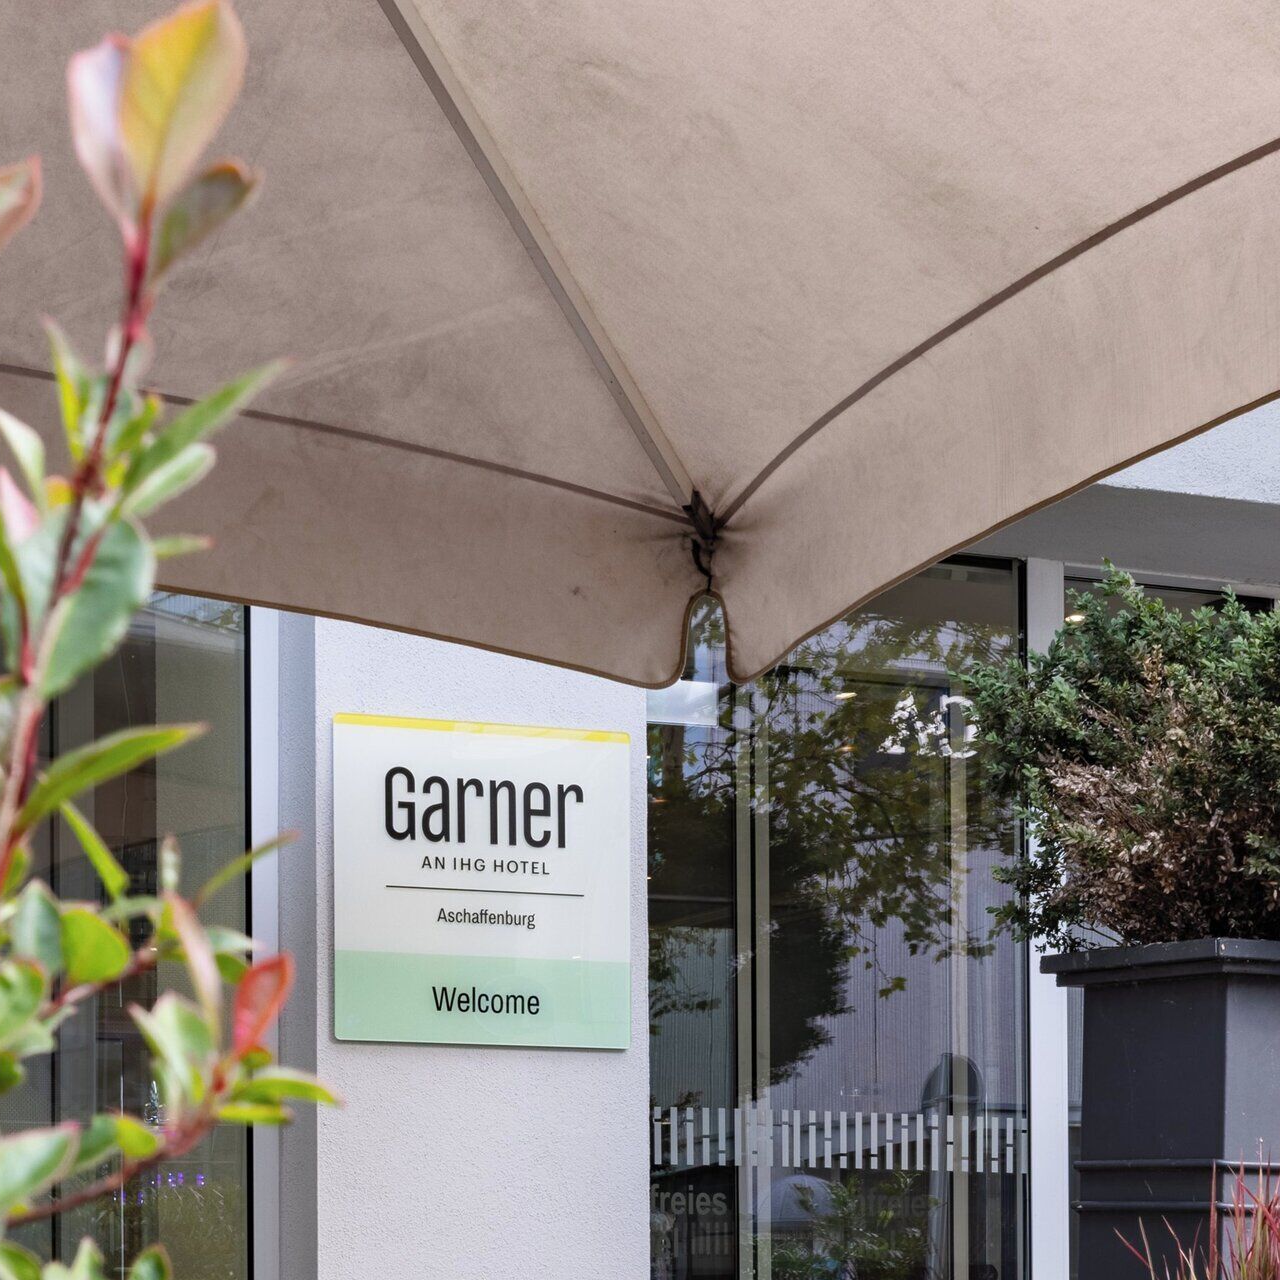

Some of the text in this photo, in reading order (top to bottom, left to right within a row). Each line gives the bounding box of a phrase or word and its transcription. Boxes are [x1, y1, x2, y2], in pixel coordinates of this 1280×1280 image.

[384, 766, 584, 849] Garner
[421, 855, 550, 875] AN IHG HOTEL
[436, 907, 536, 930] Aschaffenburg
[431, 986, 540, 1016] Welcome
